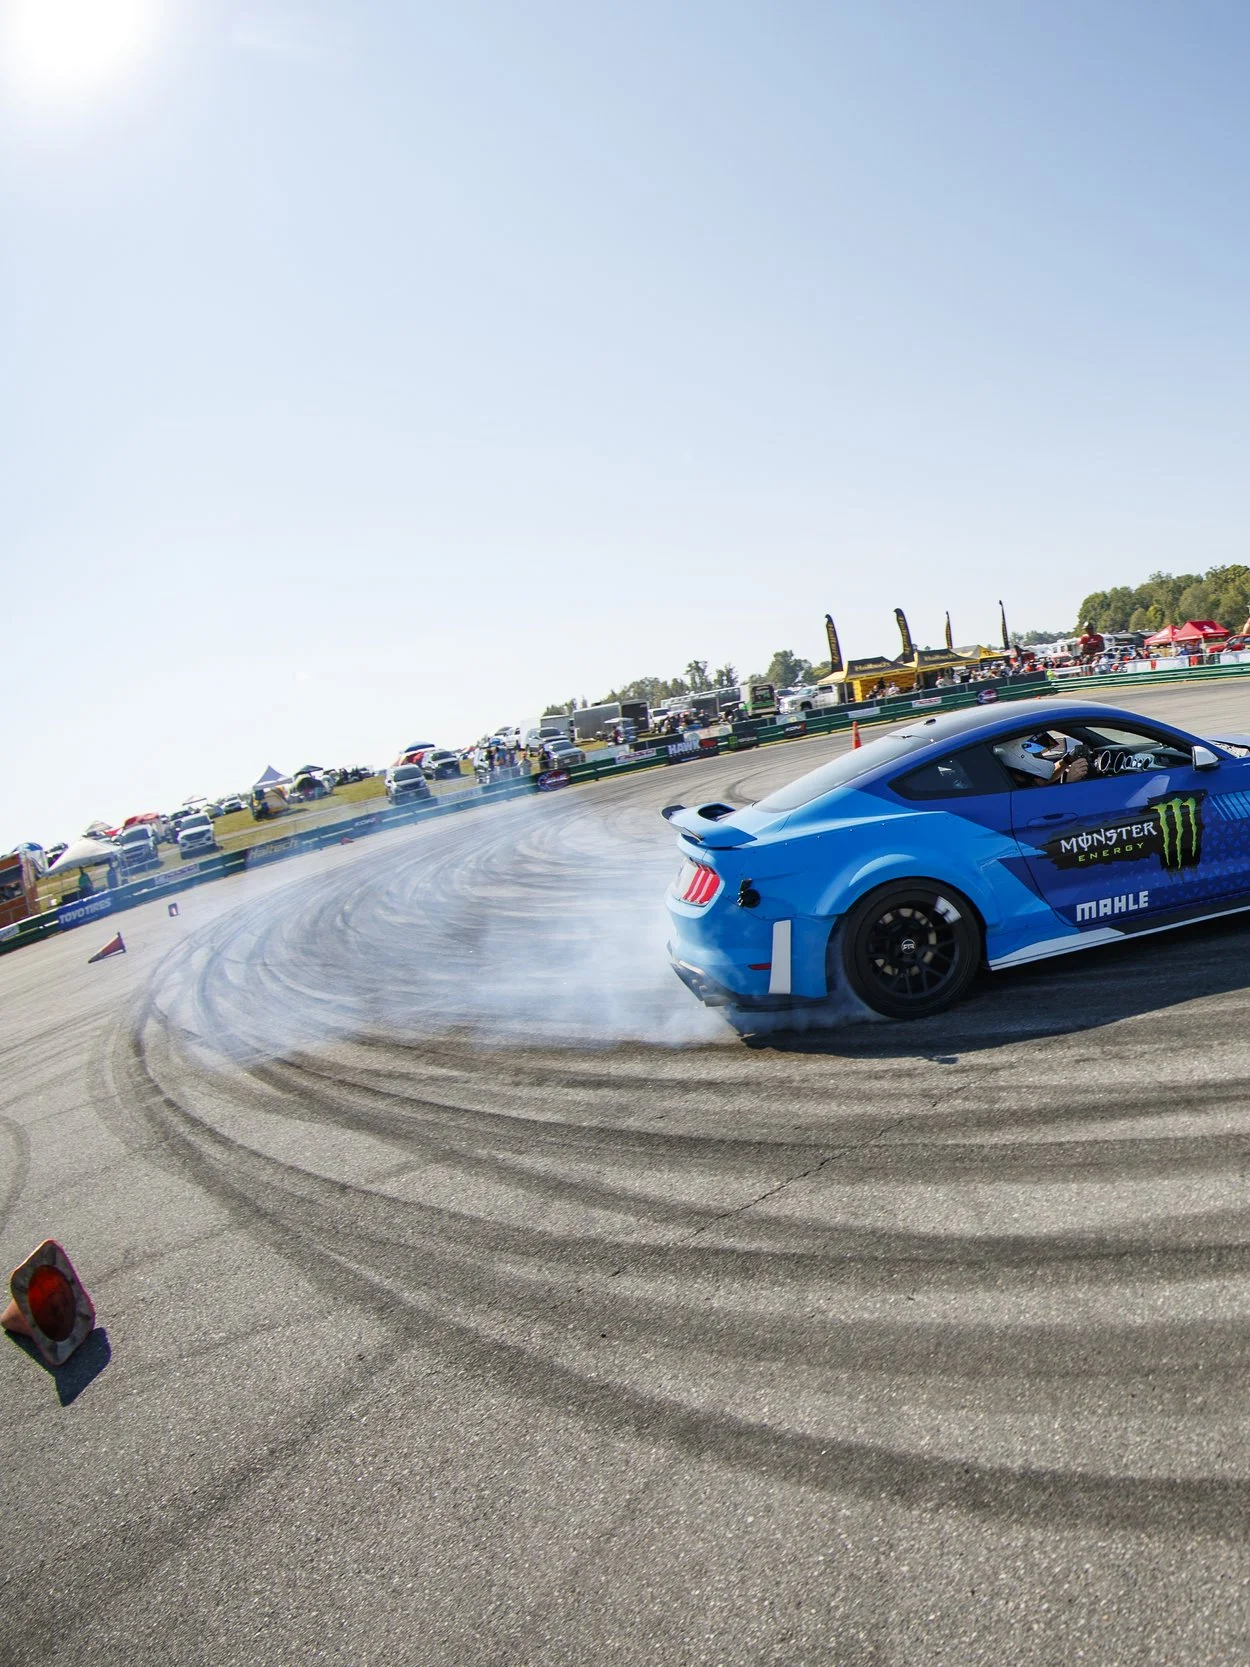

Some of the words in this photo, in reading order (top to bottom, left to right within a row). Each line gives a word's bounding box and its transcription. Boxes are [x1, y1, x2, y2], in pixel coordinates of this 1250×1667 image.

[1078, 842, 1144, 862] ENERGY
[59, 907, 85, 924] TOYO
[1076, 890, 1149, 922] MAHLE
